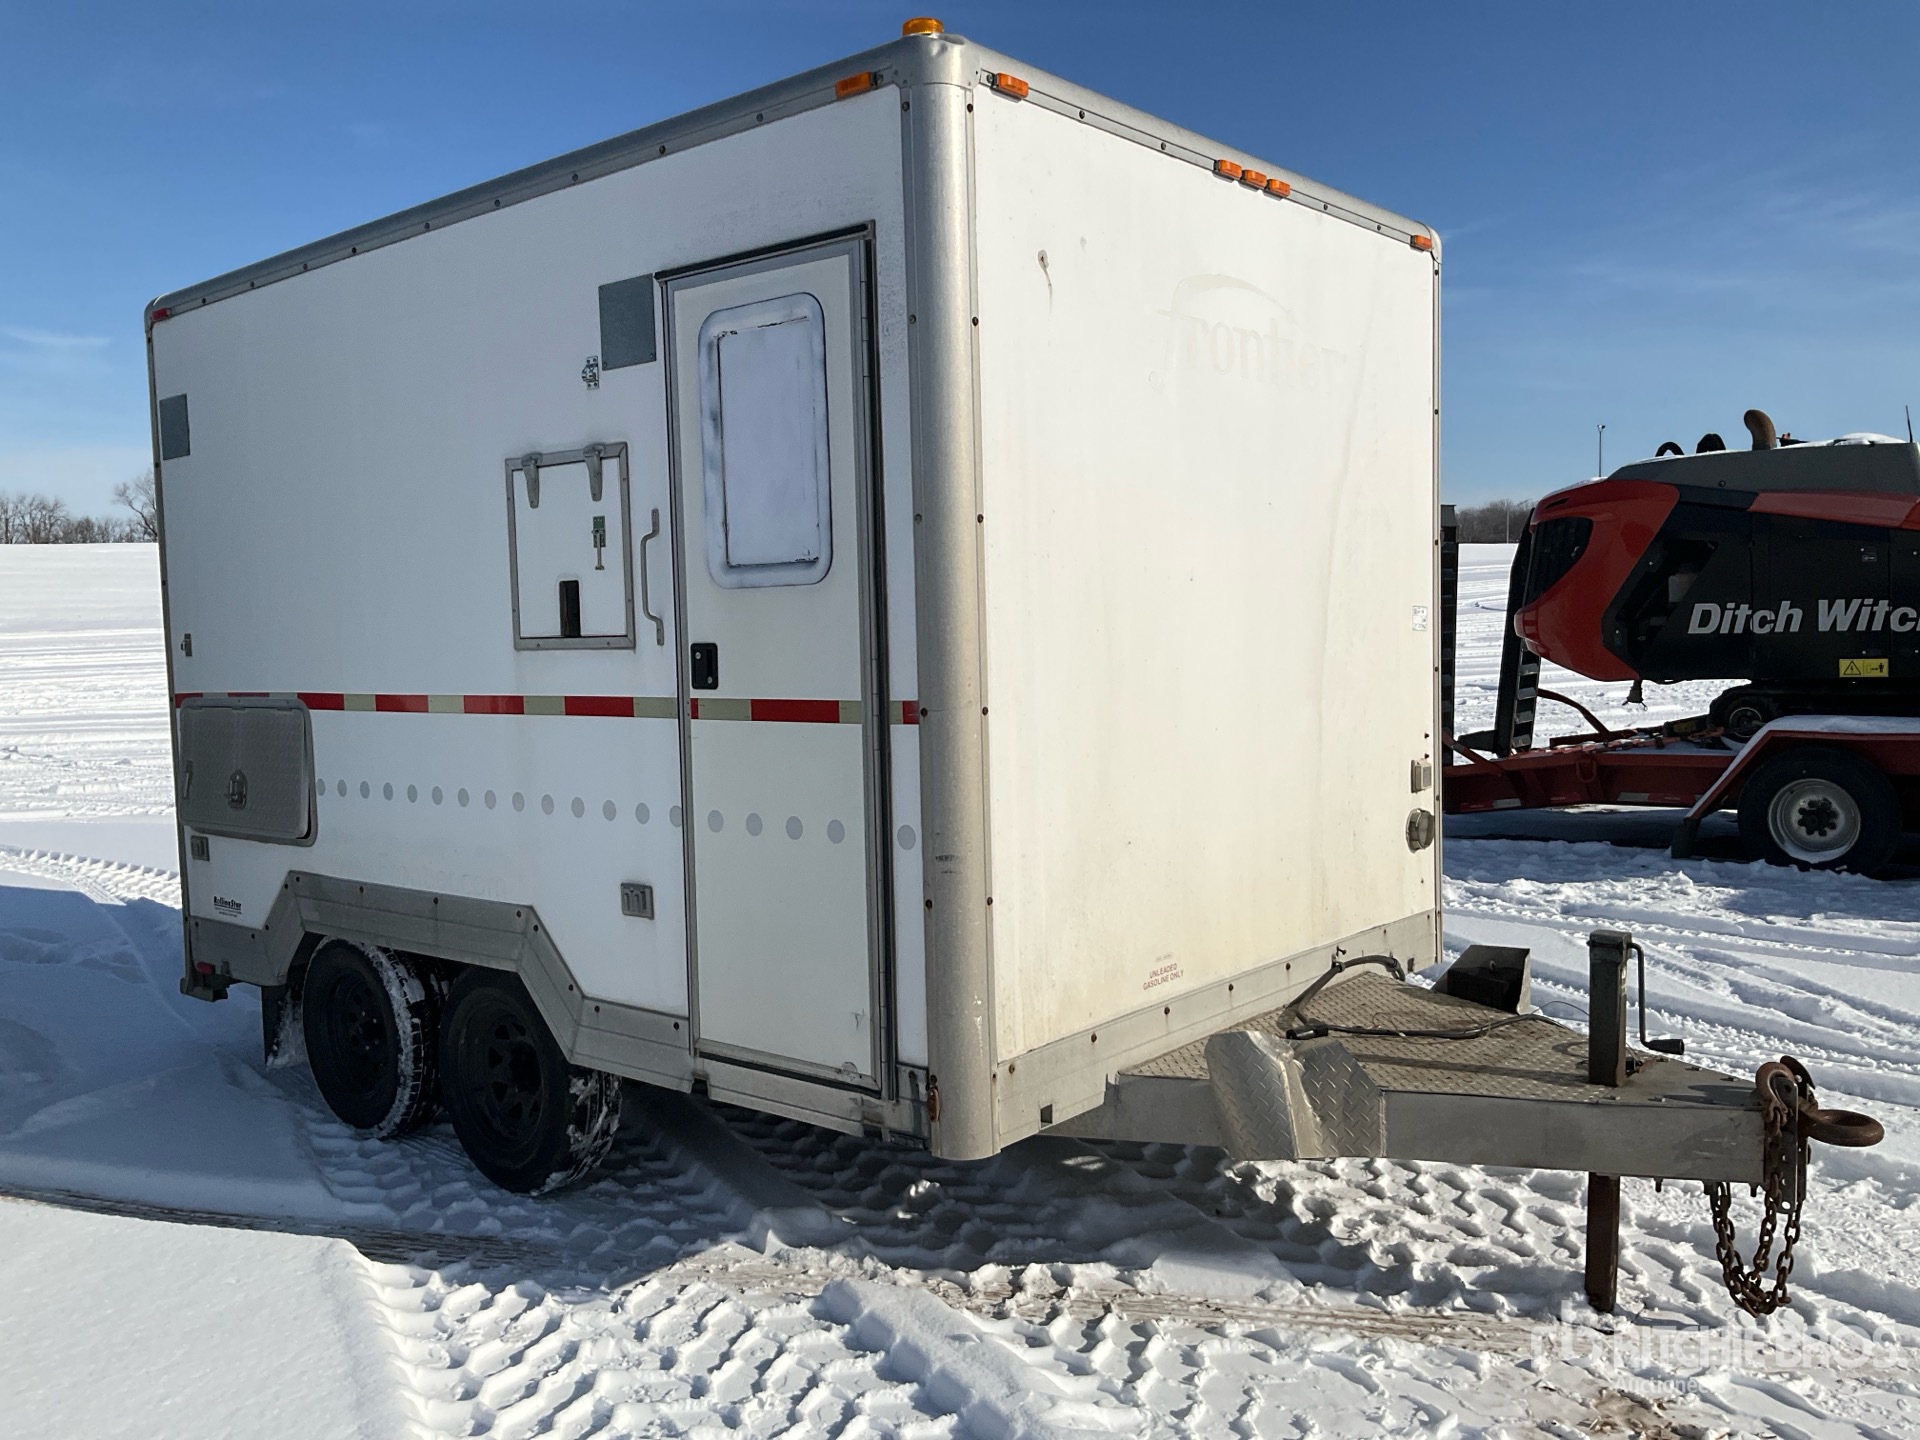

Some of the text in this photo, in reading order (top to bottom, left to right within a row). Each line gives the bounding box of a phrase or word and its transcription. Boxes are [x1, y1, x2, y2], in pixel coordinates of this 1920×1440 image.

[1687, 598, 1920, 634] Ditch Witc
[1142, 969, 1184, 990] GASOLINE ONLY
[1149, 963, 1178, 979] UNLEADED
